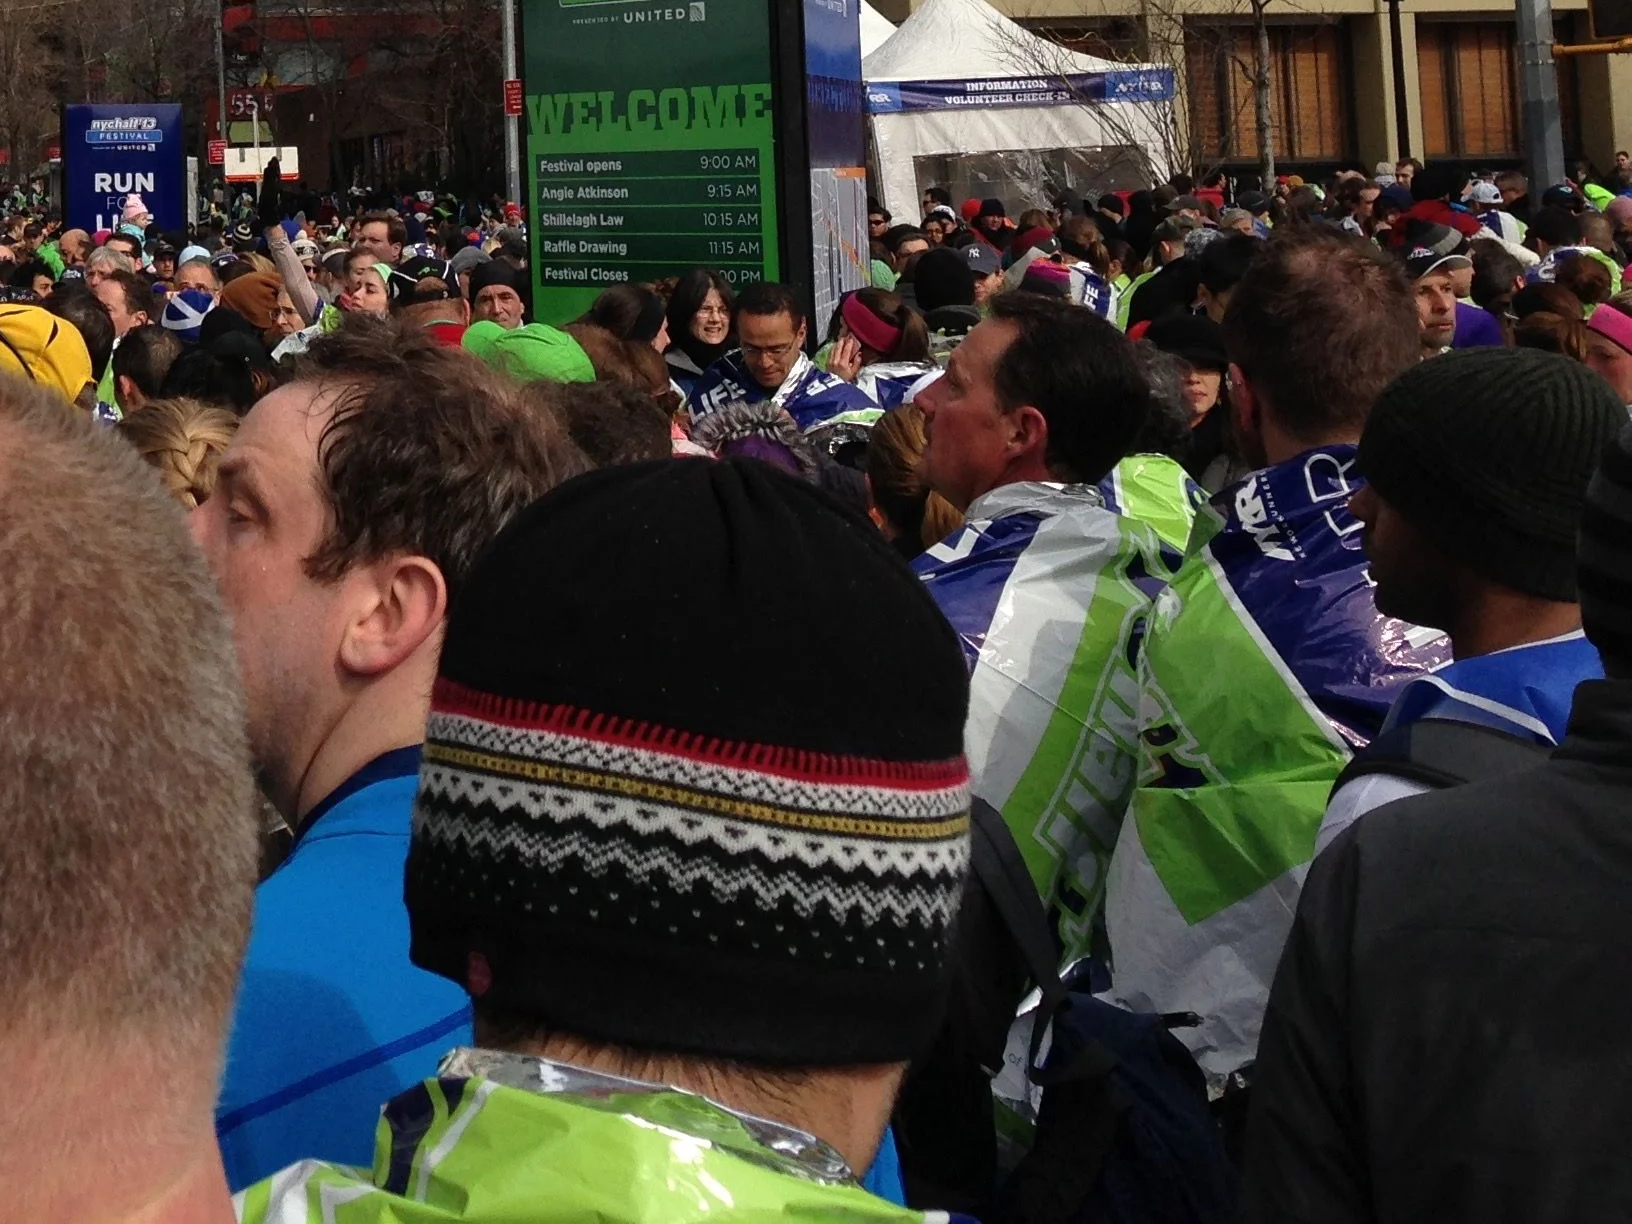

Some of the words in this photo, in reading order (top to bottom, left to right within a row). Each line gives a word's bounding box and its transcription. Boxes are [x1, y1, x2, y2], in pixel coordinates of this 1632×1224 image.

[623, 8, 686, 24] UNITED
[966, 79, 1048, 92] INFORMATION
[944, 93, 1014, 105] VOLUNTEER
[1015, 91, 1070, 103] CHECK-IN
[526, 83, 773, 134] WELCOME
[99, 132, 149, 140] FESTIVAL
[540, 159, 584, 172] Festival
[586, 160, 623, 173] opens
[700, 155, 730, 169] 9:00
[734, 155, 756, 168] AM
[94, 172, 154, 193] RUN
[541, 186, 574, 201] Angie
[576, 185, 629, 199] Atkinson
[707, 184, 732, 197] 9:15
[735, 184, 757, 197] AM
[542, 213, 597, 228] Shillelagh
[599, 213, 624, 226] Law
[703, 212, 733, 226] 10:15
[737, 213, 759, 226] AM
[544, 239, 577, 253] Raffle
[579, 240, 628, 256] Drawing
[708, 241, 734, 255] 11:15
[738, 241, 760, 255] AM
[544, 267, 588, 280] Festival
[590, 267, 629, 281] Closes
[740, 270, 761, 284] PM
